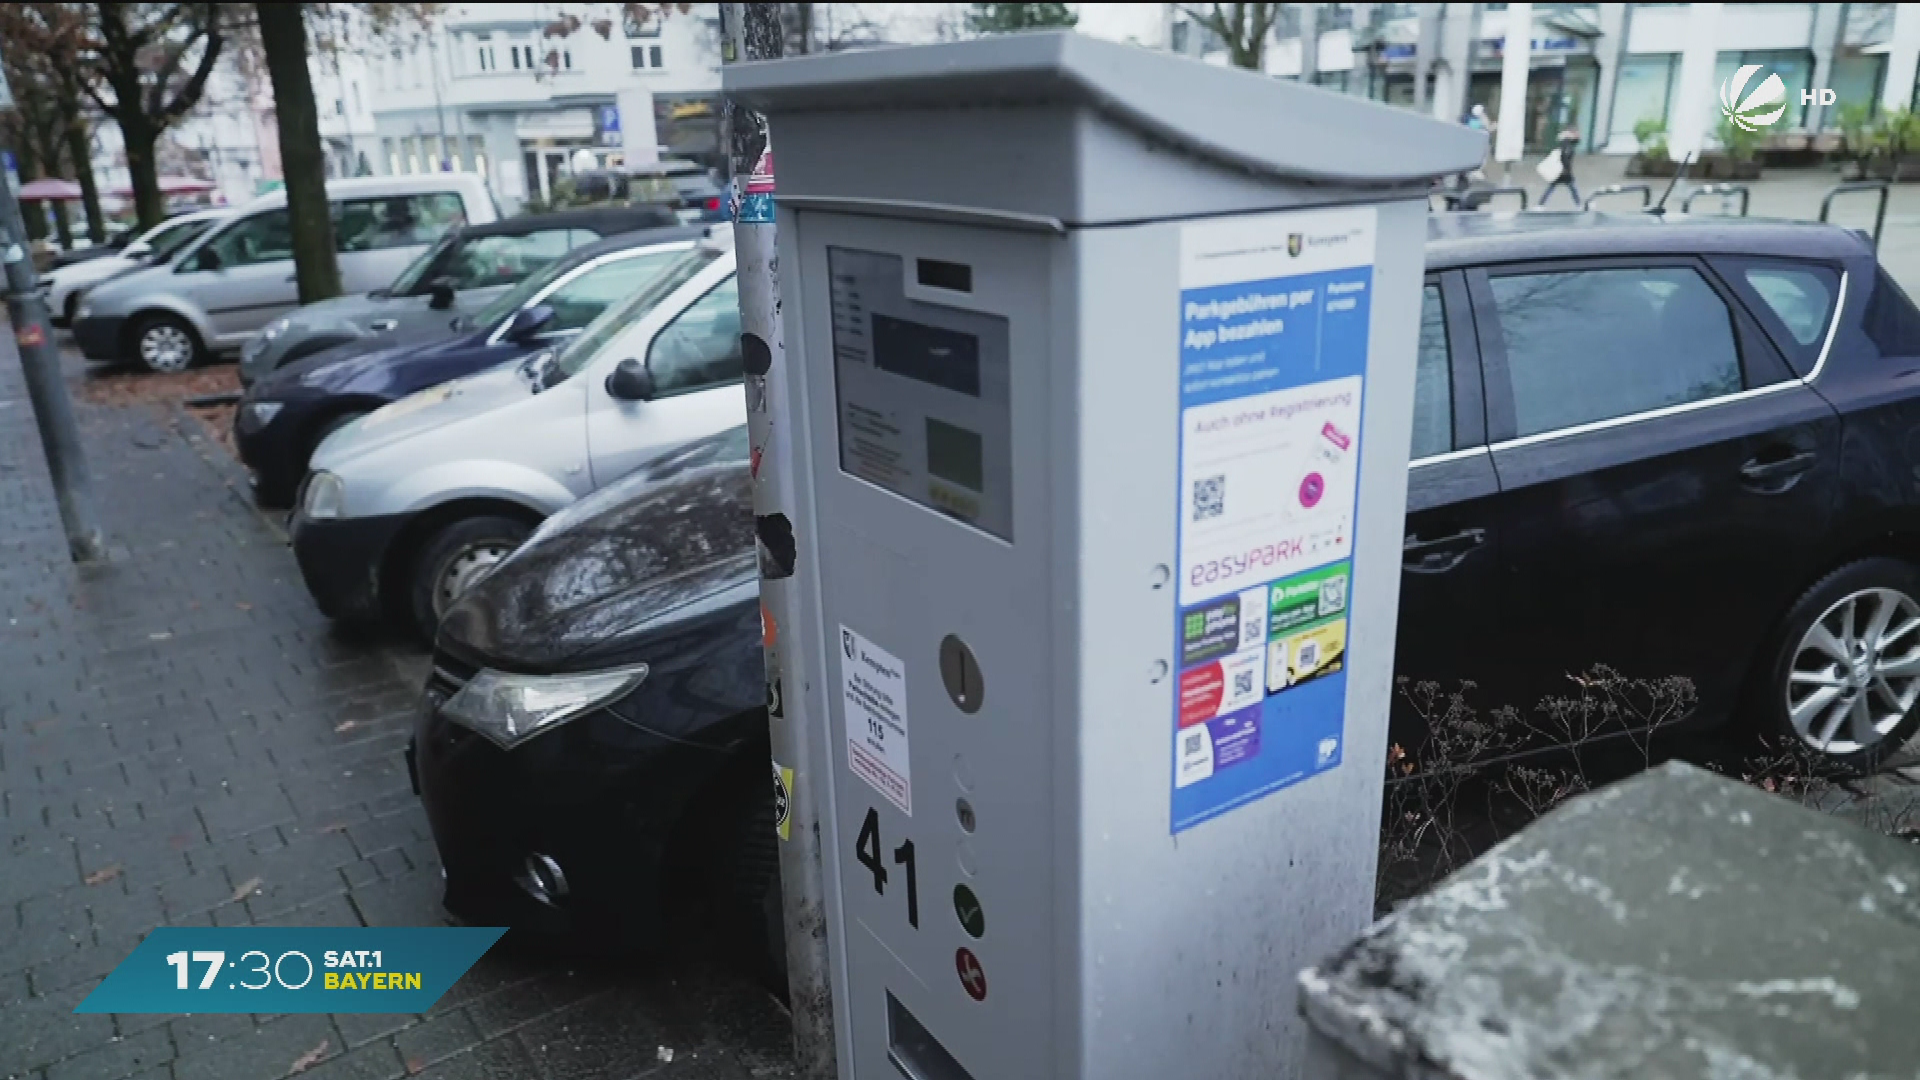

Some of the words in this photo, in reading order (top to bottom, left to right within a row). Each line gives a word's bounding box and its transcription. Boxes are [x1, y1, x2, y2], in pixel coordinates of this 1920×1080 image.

[1185, 293, 1288, 320] Parkgebühren
[1289, 289, 1314, 310] per
[1184, 329, 1216, 350] App
[1217, 318, 1284, 343] bezahlen
[1232, 410, 1265, 427] ohne
[1270, 393, 1352, 419] Registrierung
[868, 717, 884, 740] 115
[856, 807, 919, 930] 41
